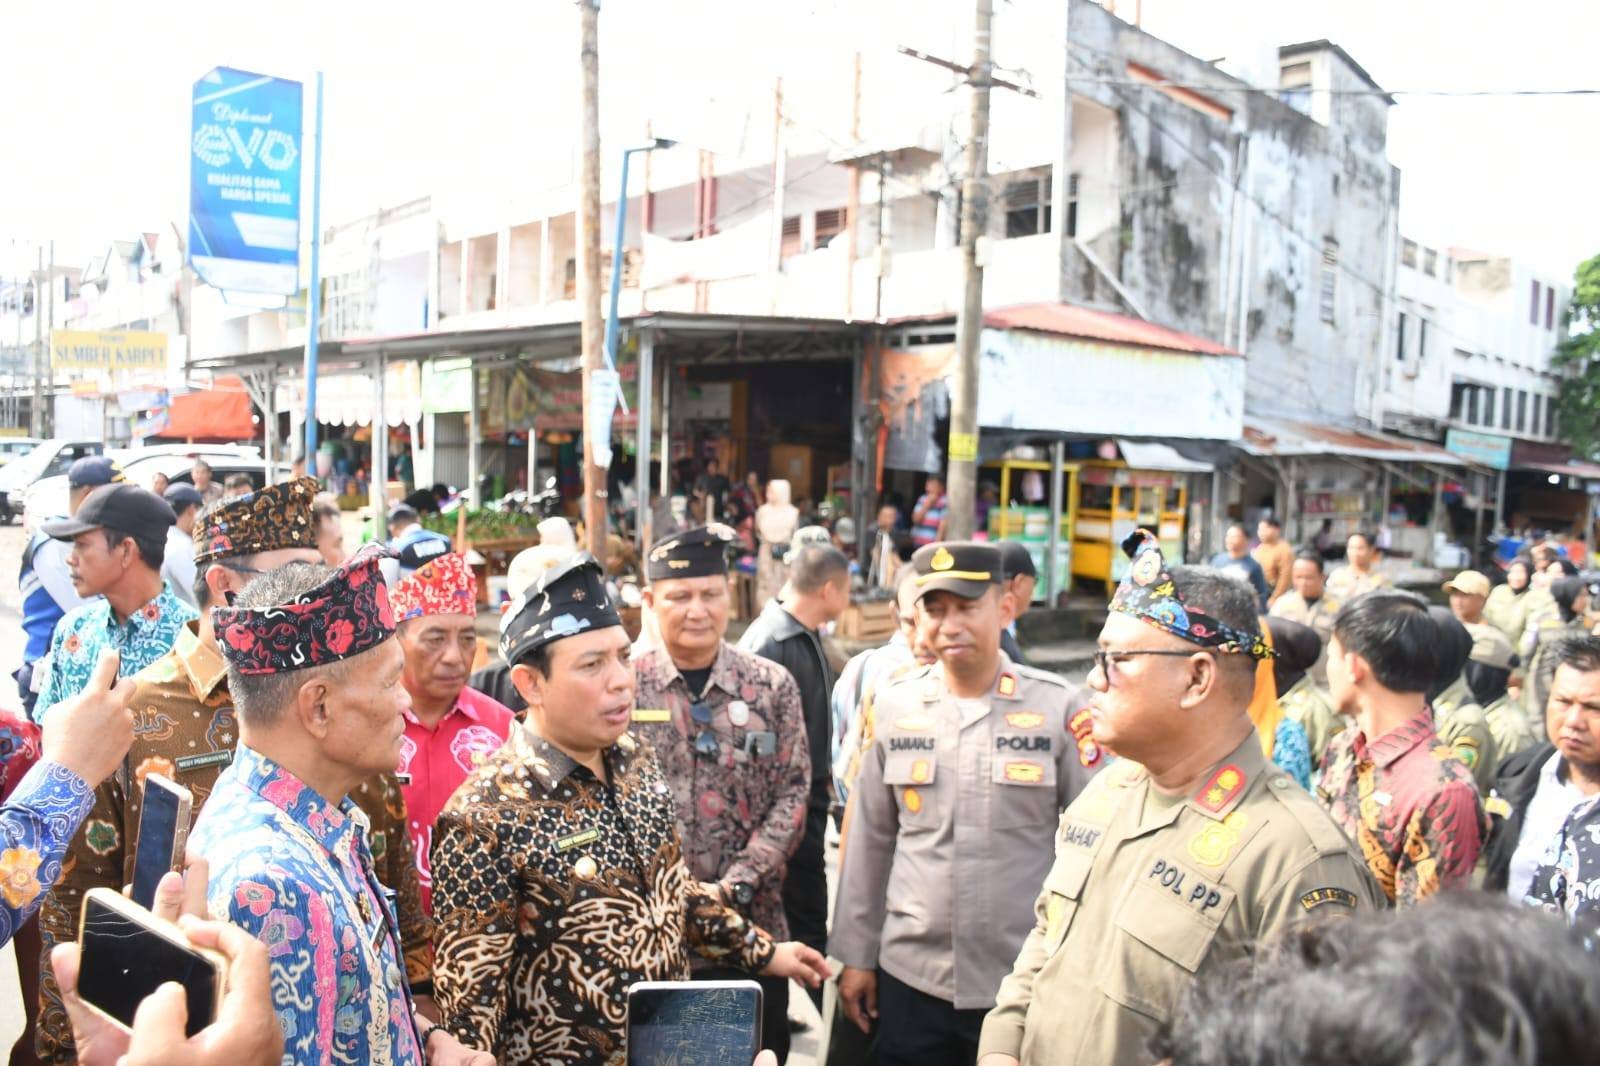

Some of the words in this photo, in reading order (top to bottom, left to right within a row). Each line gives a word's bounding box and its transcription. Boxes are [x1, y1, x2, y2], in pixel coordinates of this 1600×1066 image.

[254, 177, 281, 190] SAMA
[220, 188, 253, 201] HARGA
[55, 346, 111, 361] SUMBER
[116, 346, 165, 362] KARPET
[996, 736, 1052, 751] POLRI
[1149, 858, 1186, 896] POL
[1189, 881, 1222, 914] PP
